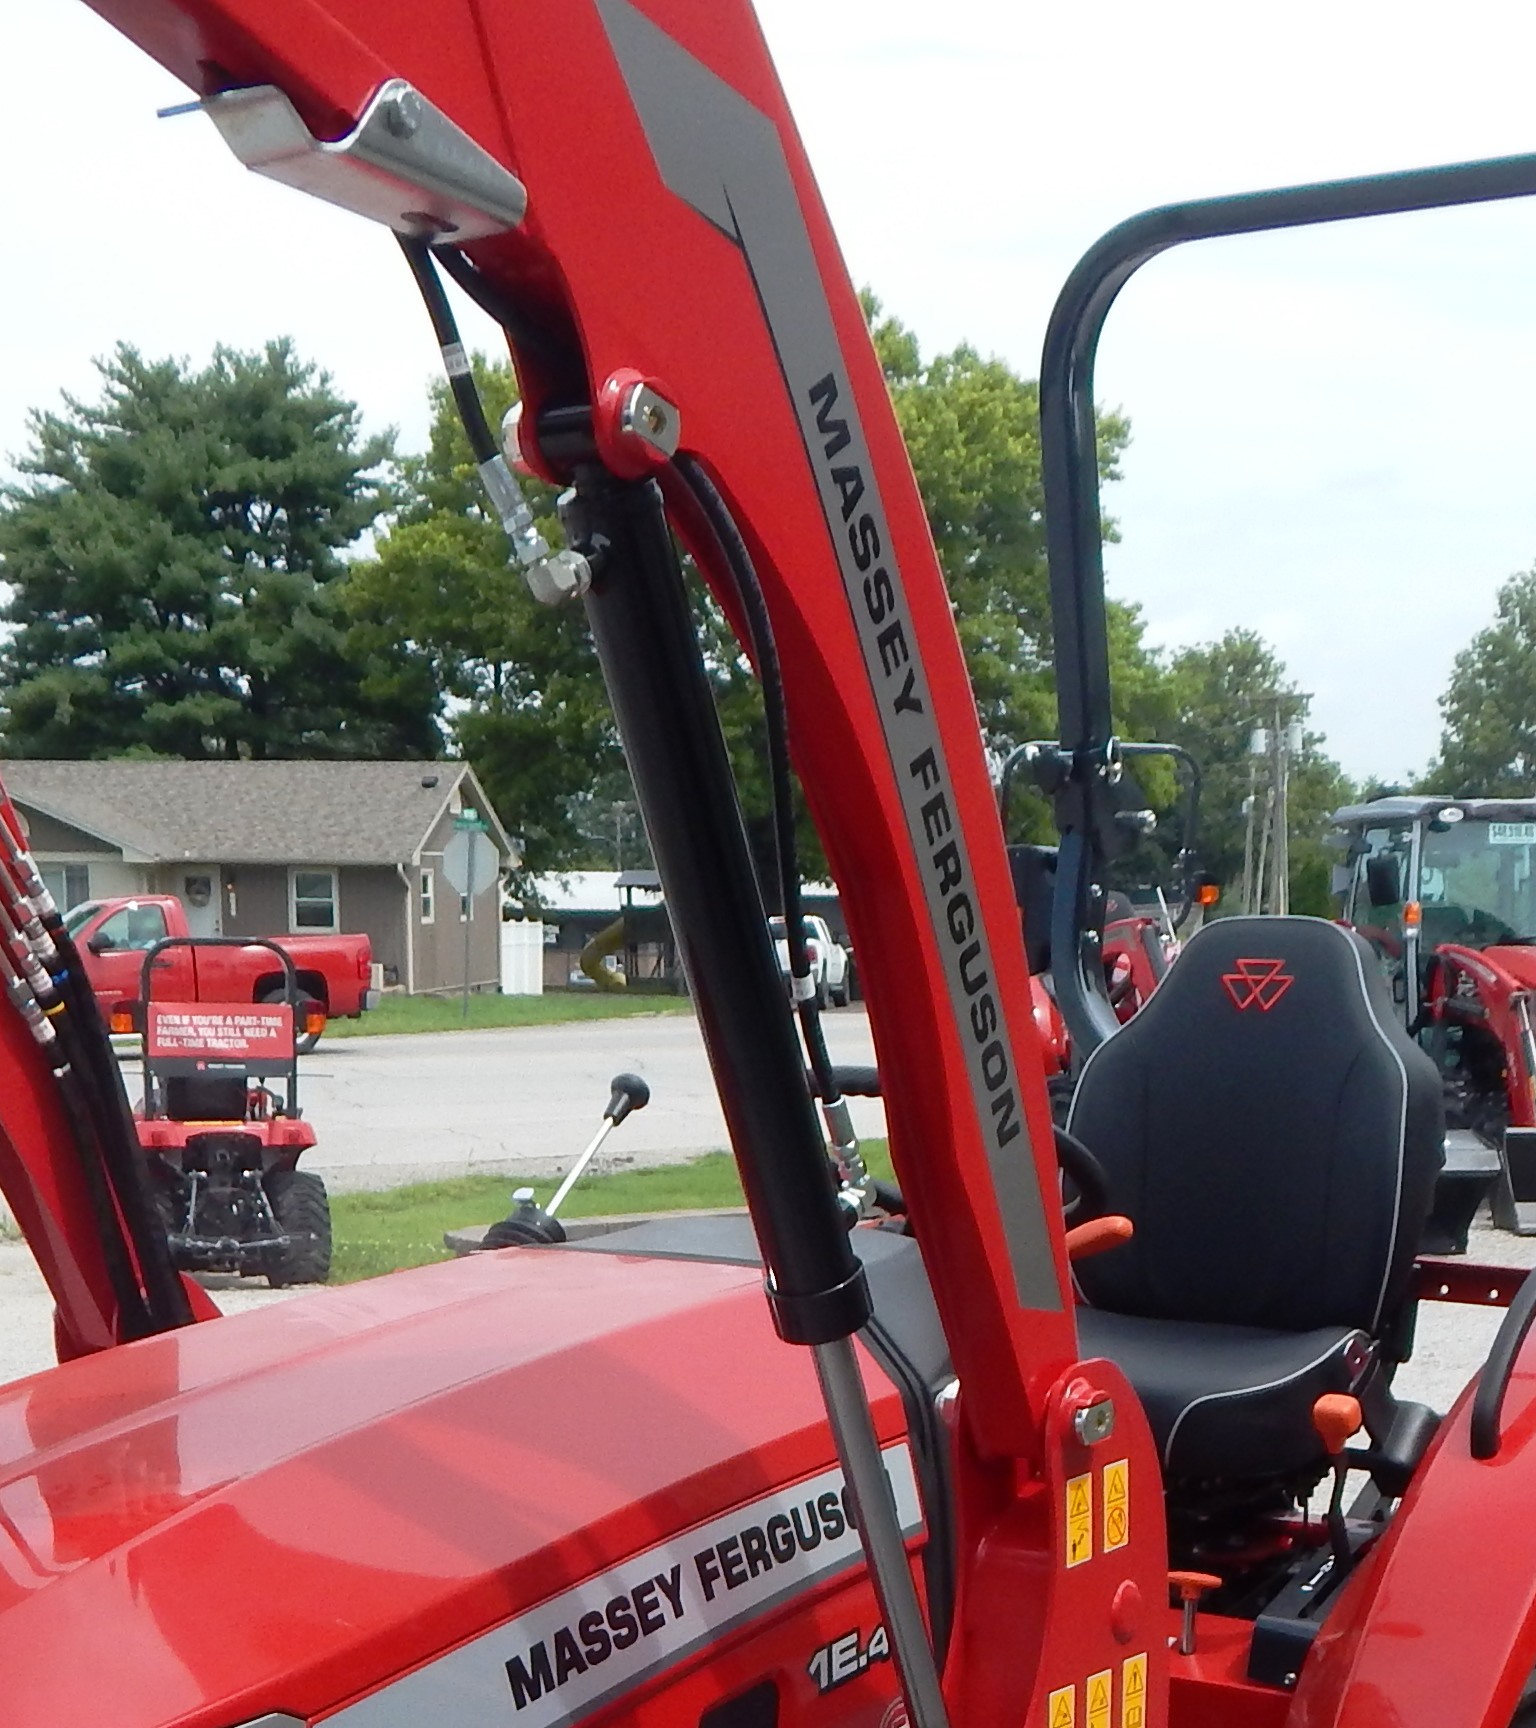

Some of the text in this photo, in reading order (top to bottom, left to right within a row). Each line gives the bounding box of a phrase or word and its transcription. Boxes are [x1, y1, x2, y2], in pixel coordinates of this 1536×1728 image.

[808, 372, 1022, 1149] MASSEY FERGUSON
[225, 1015, 233, 1026] A
[198, 1027, 215, 1037] YOU
[217, 1027, 241, 1038] STILL
[244, 1027, 267, 1038] NEED
[269, 1027, 277, 1038] A
[156, 1037, 205, 1048] FULL-TIME
[505, 1469, 898, 1711] MASSEY FERGUS
